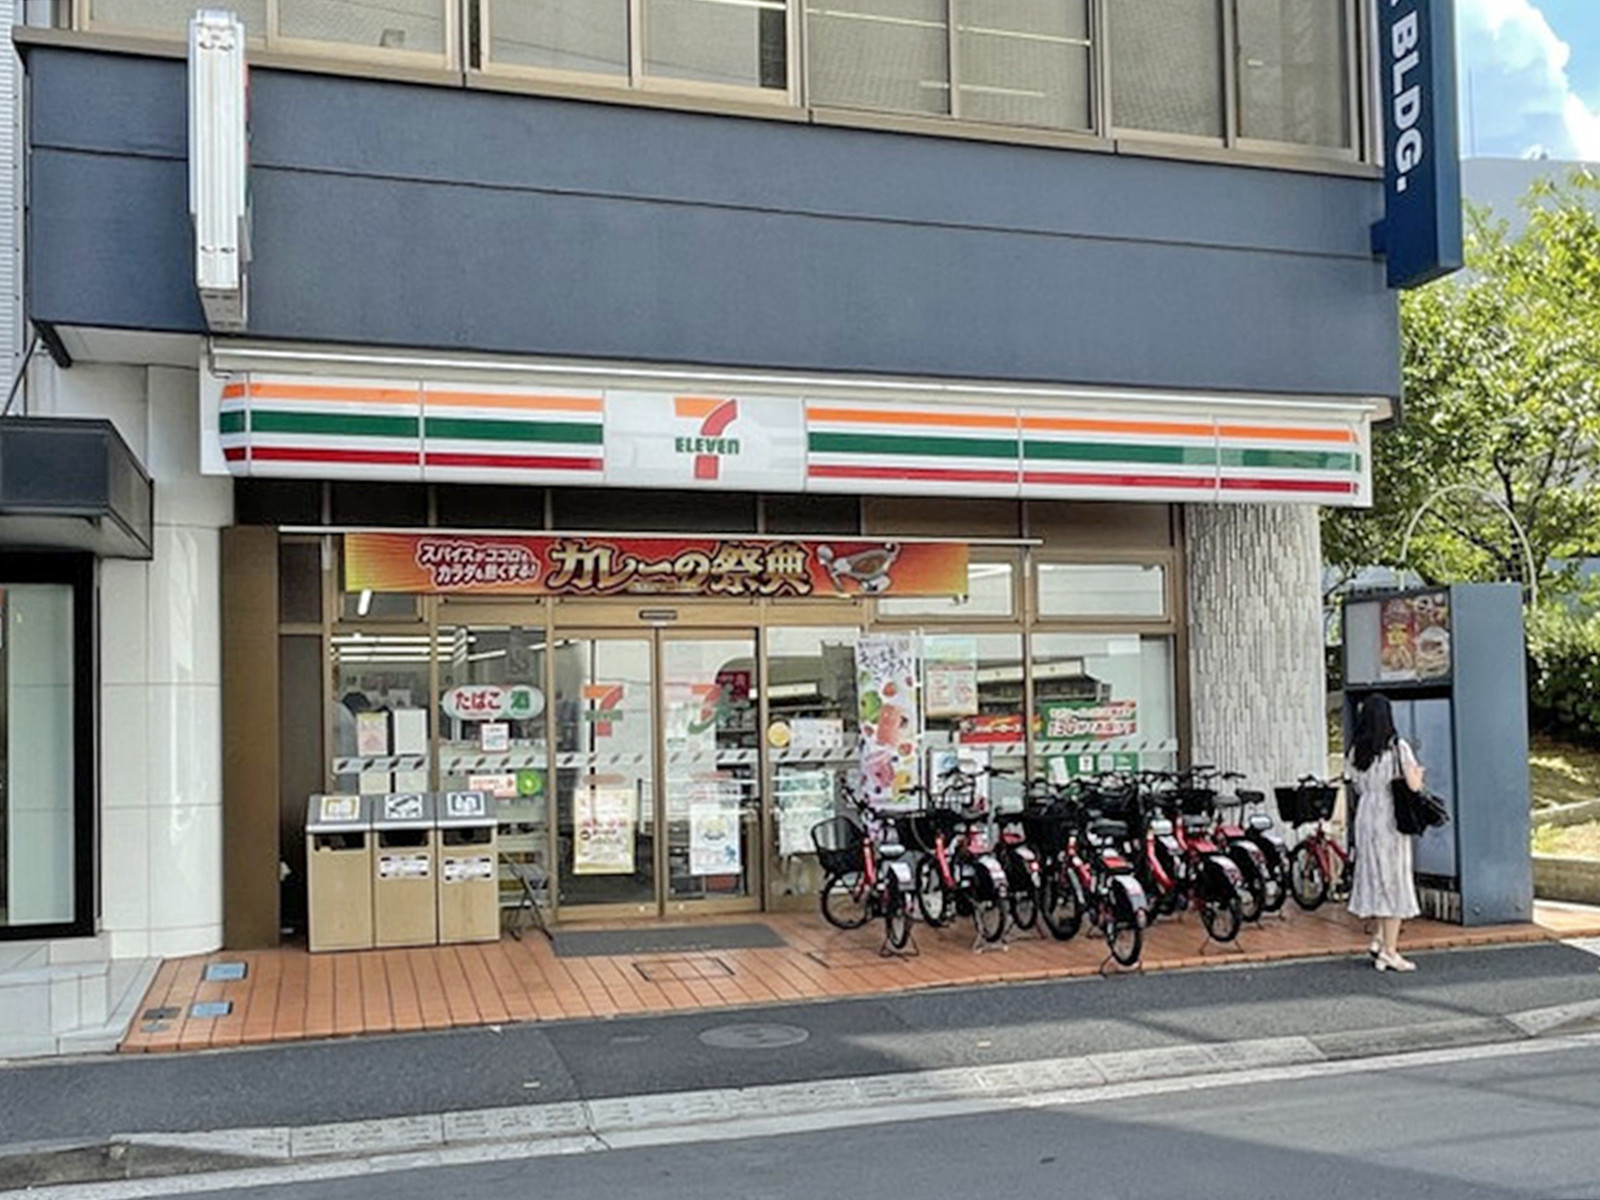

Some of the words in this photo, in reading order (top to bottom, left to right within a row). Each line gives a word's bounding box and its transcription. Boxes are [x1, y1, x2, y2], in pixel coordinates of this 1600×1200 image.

[1391, 11, 1422, 192] BLDG.
[674, 397, 737, 480] 7
[548, 540, 811, 595] カレーの祭典
[456, 691, 501, 710] たばこ
